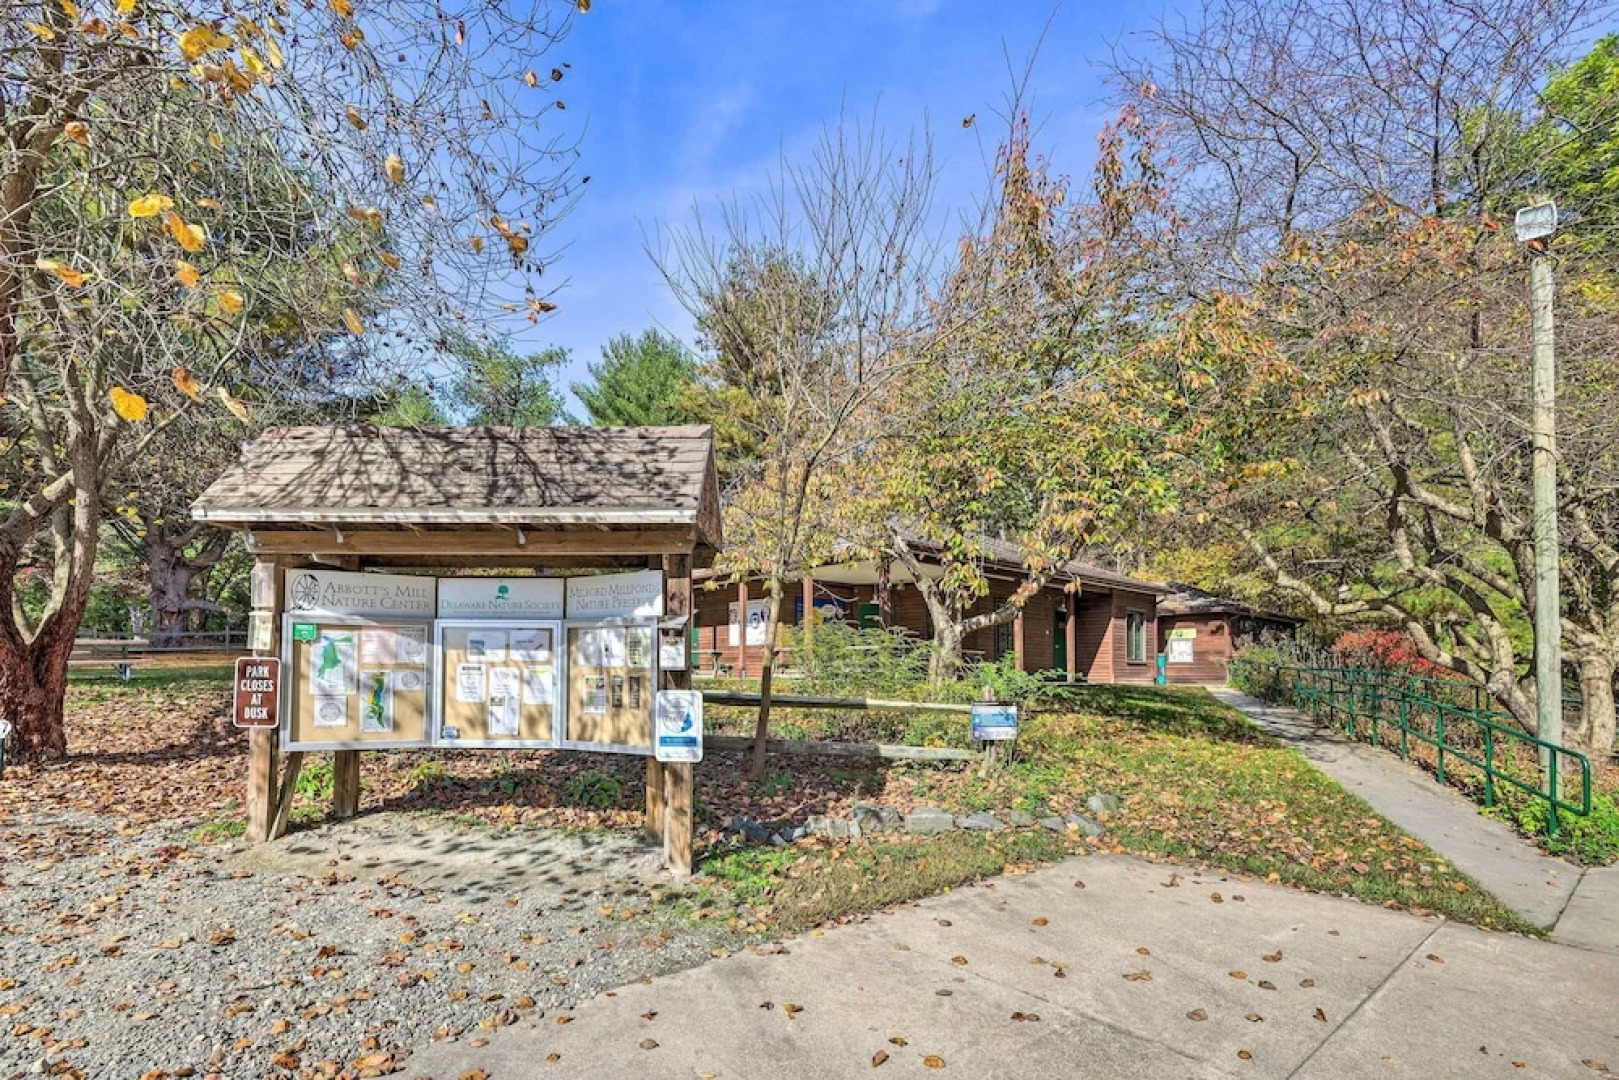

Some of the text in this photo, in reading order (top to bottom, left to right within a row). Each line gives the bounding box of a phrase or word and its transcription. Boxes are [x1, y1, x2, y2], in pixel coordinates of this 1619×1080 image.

[394, 586, 428, 597] MILL
[321, 594, 430, 610] NATURE CENTER
[440, 600, 560, 610] DELAWARE NATURE SOCIETY
[246, 666, 270, 678] PARK
[240, 680, 275, 692] CLOSES
[251, 693, 262, 705] AT
[244, 707, 268, 719] DUSK
